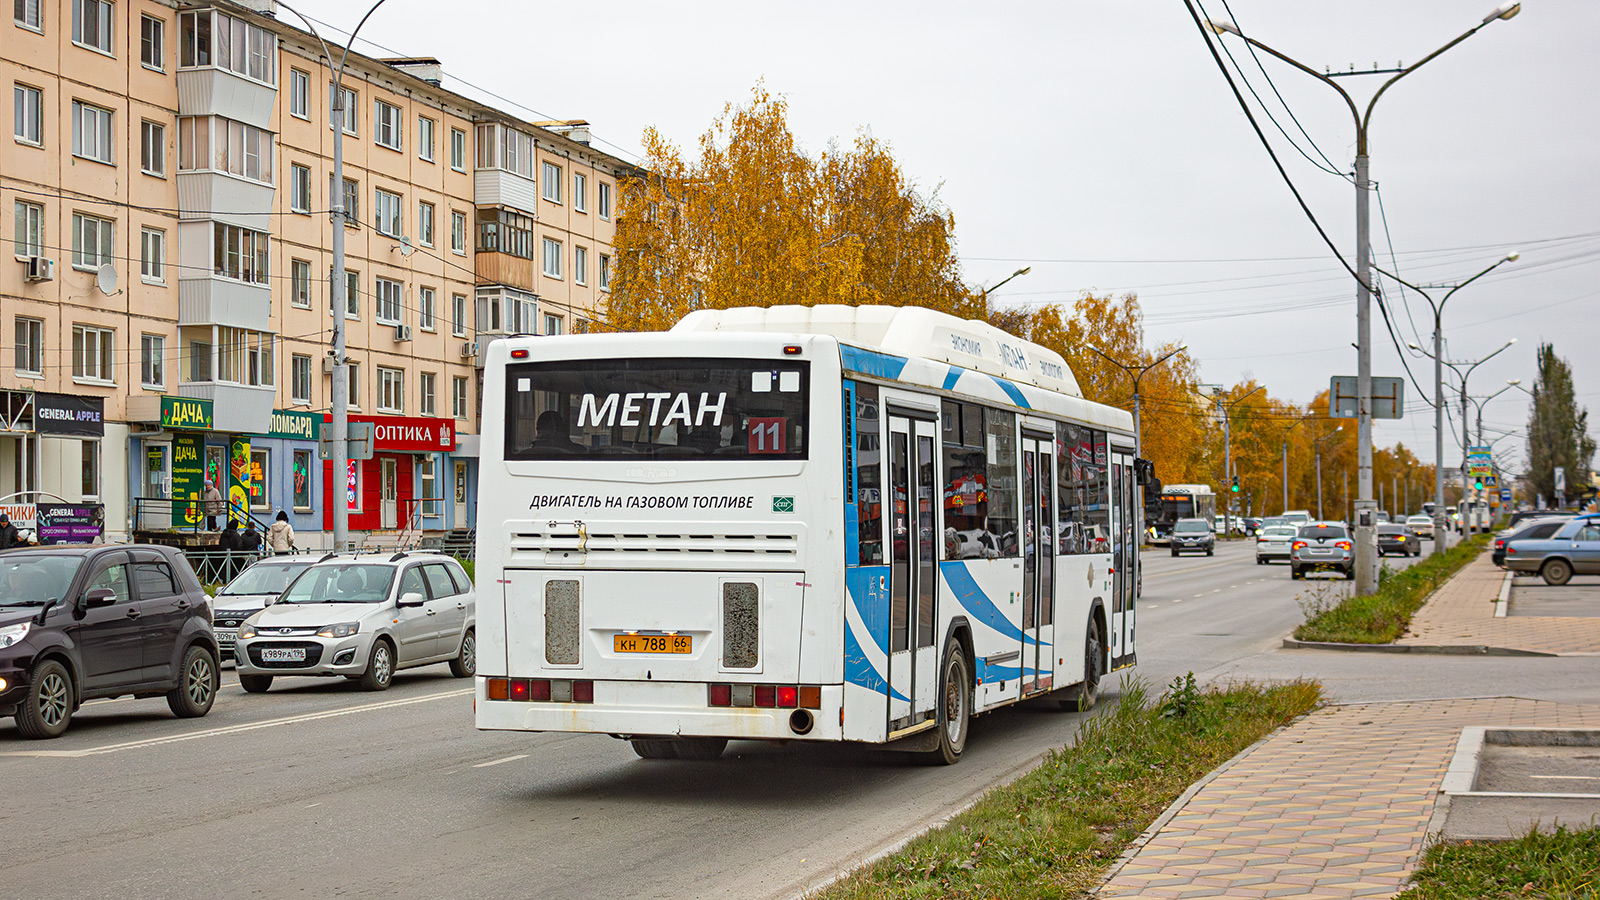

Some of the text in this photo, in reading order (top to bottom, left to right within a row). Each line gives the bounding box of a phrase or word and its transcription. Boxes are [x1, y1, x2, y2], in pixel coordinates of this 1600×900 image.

[996, 341, 1028, 371] МЕТАН
[39, 408, 100, 422] GENERAL APPLE
[171, 402, 204, 426] ДАЧА
[577, 392, 727, 427] МЕТАН
[269, 414, 313, 438] ЛОМБАРД
[375, 425, 432, 441] ОПТИКА
[751, 422, 780, 450] 11
[175, 446, 198, 463] ДАЧА
[529, 495, 754, 510] ДВИГАТЕЛЬ НА ГАЗОВОМ ТОПЛИВЕ
[49, 508, 74, 516] GENERAL
[620, 637, 687, 651] КН 788 66
